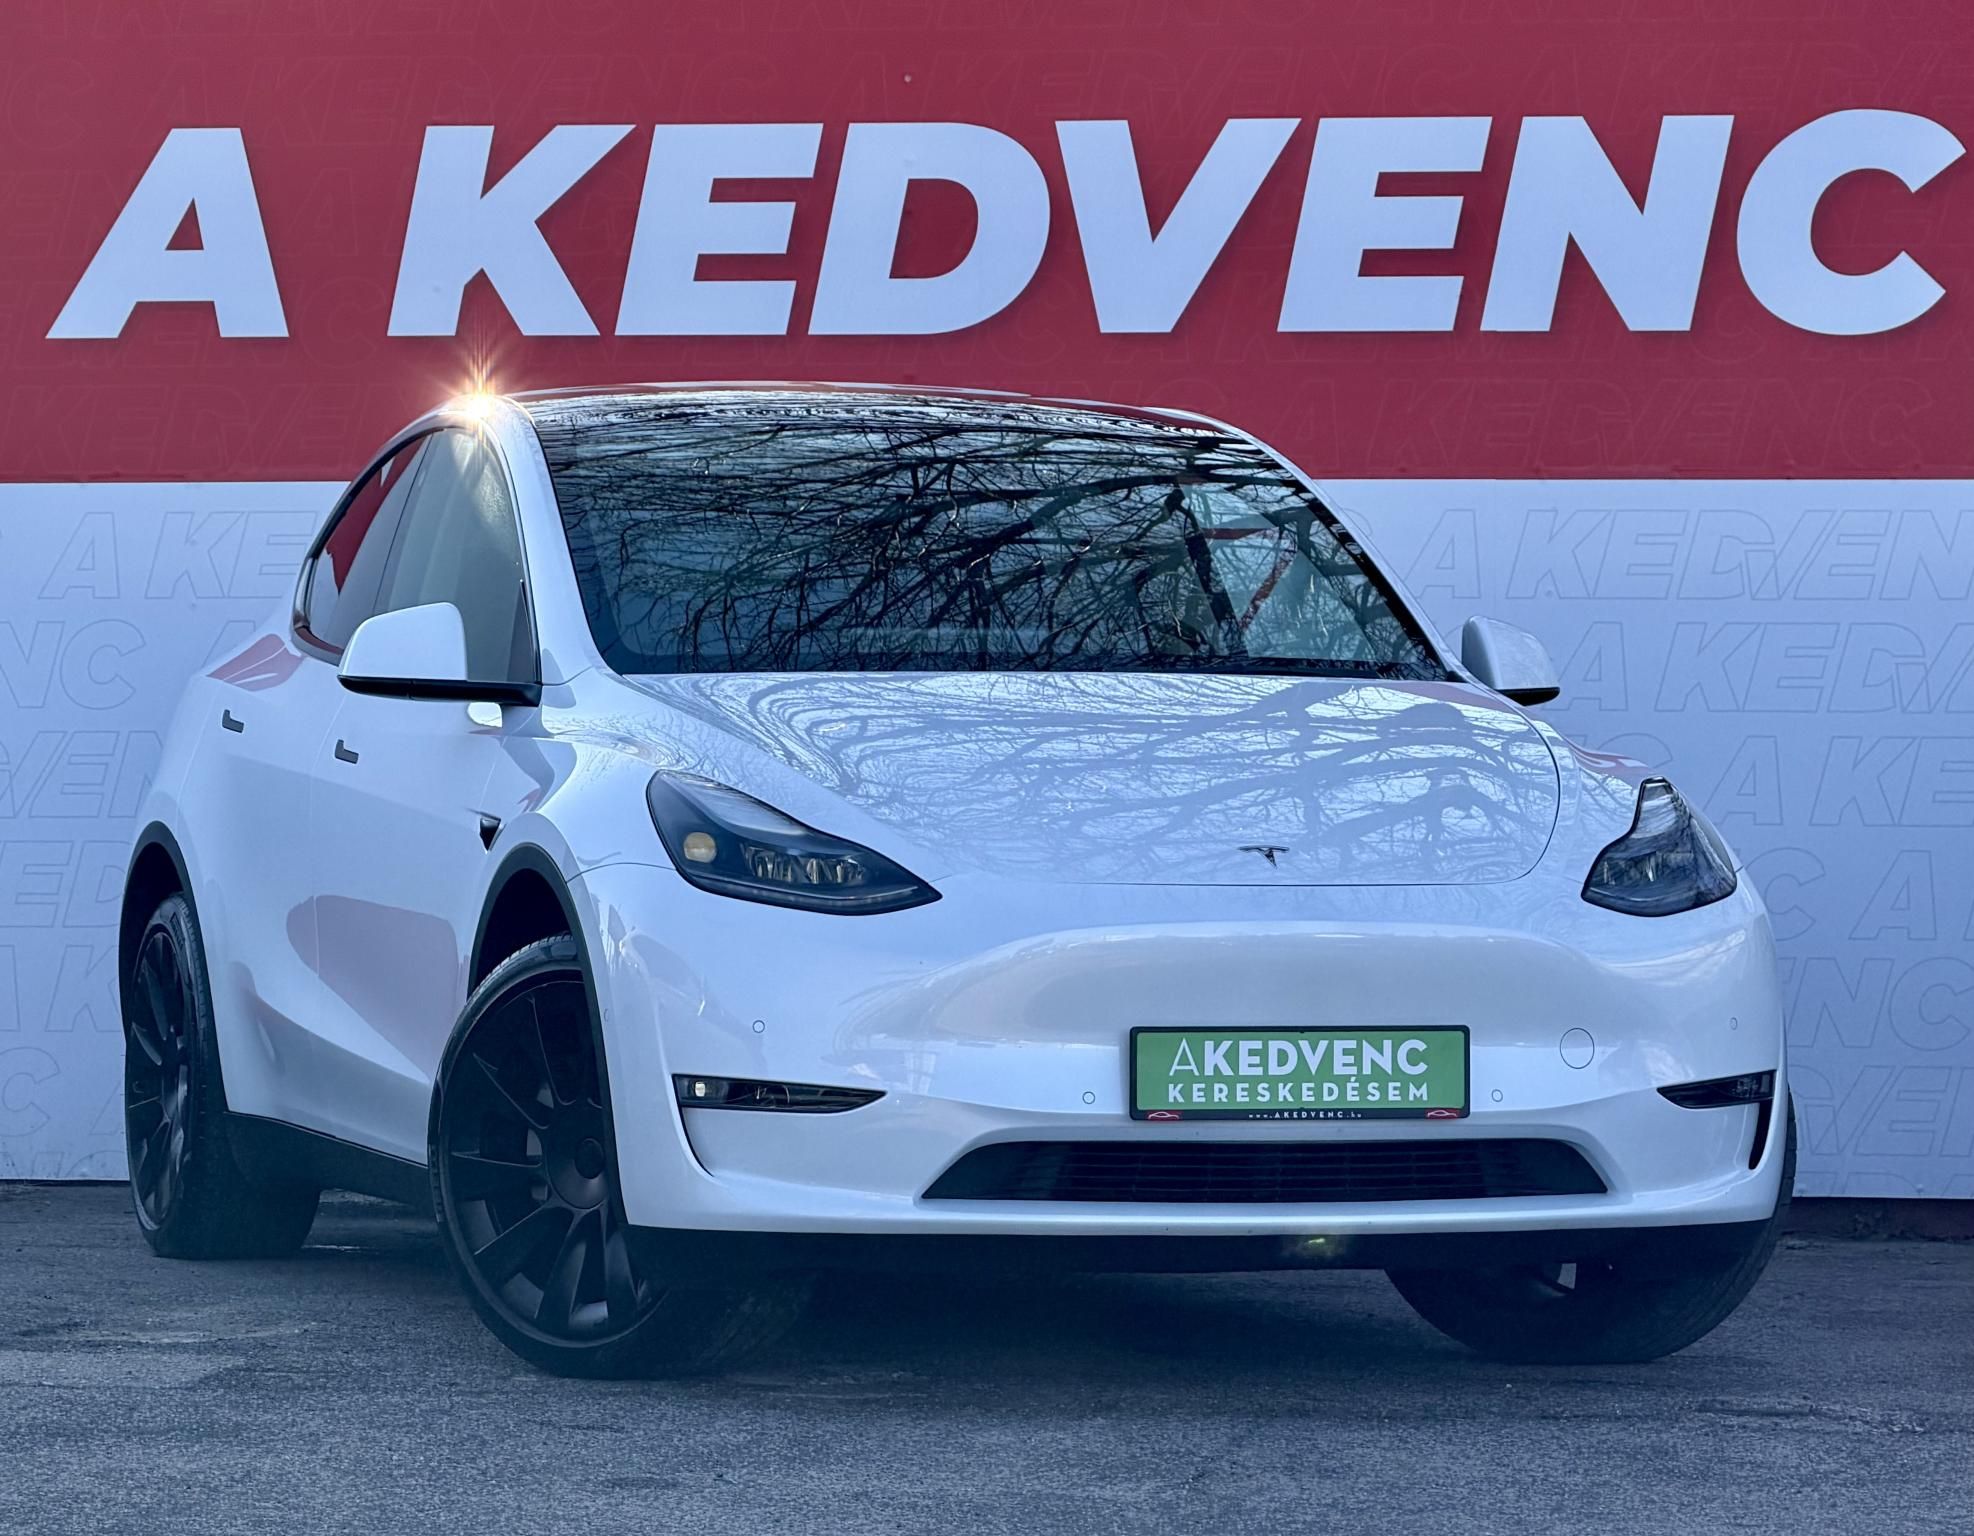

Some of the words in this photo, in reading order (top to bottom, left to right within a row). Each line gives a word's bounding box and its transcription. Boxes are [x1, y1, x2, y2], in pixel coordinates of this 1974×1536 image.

[46, 126, 291, 341] A
[387, 108, 1966, 338] KEDVENC
[38, 511, 121, 600] A
[1402, 509, 1482, 600] A
[1543, 621, 1629, 712] A
[1848, 849, 1938, 941] A
[1168, 1076, 1429, 1103] KERESKEDÉSEM
